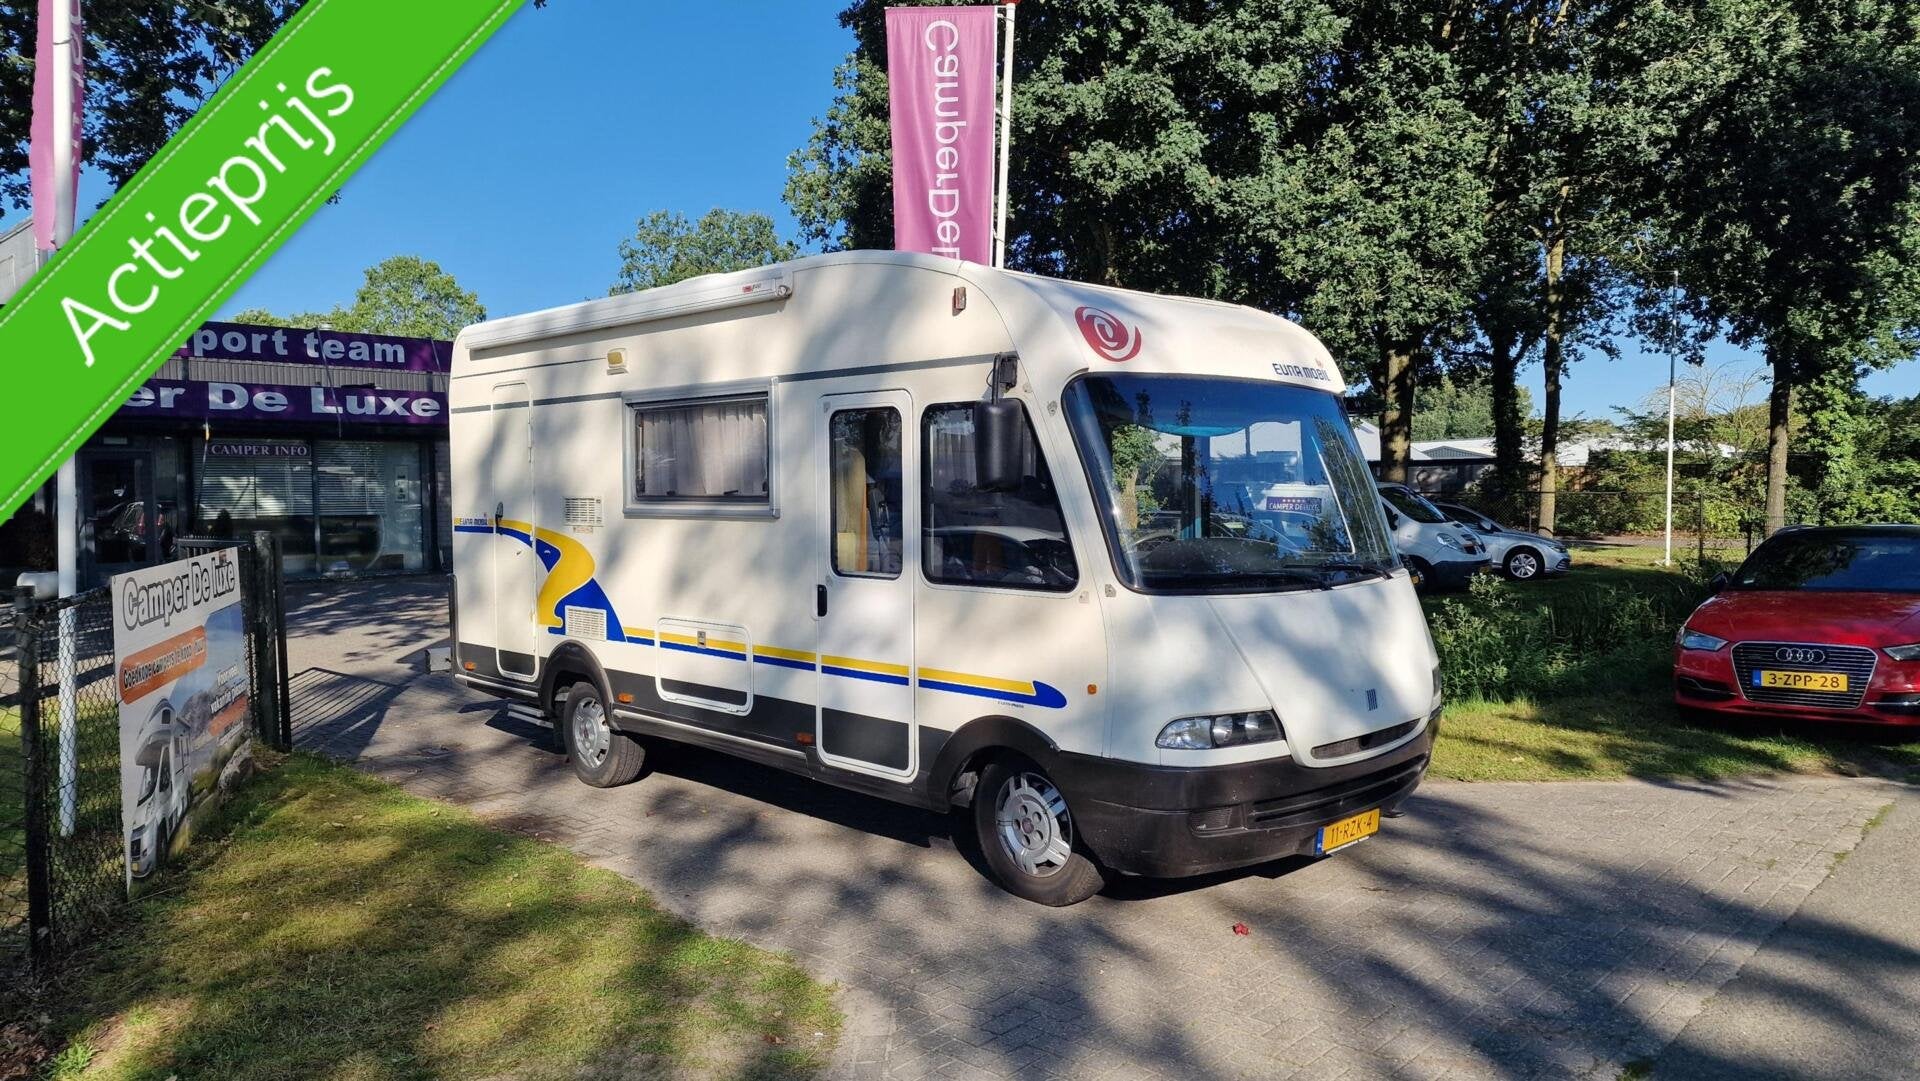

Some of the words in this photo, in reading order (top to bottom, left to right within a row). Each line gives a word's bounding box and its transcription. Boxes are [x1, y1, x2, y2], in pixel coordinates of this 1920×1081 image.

[178, 328, 288, 357] port
[304, 329, 405, 363] team
[208, 382, 288, 412] De
[311, 387, 440, 416] Luxe
[211, 444, 269, 455] CAMPER
[275, 446, 307, 456] INFO
[123, 573, 189, 631] Camper
[191, 561, 210, 606] De
[1769, 673, 1840, 688] 3-ZPP-28
[1330, 814, 1373, 845] 11-RZK-4
